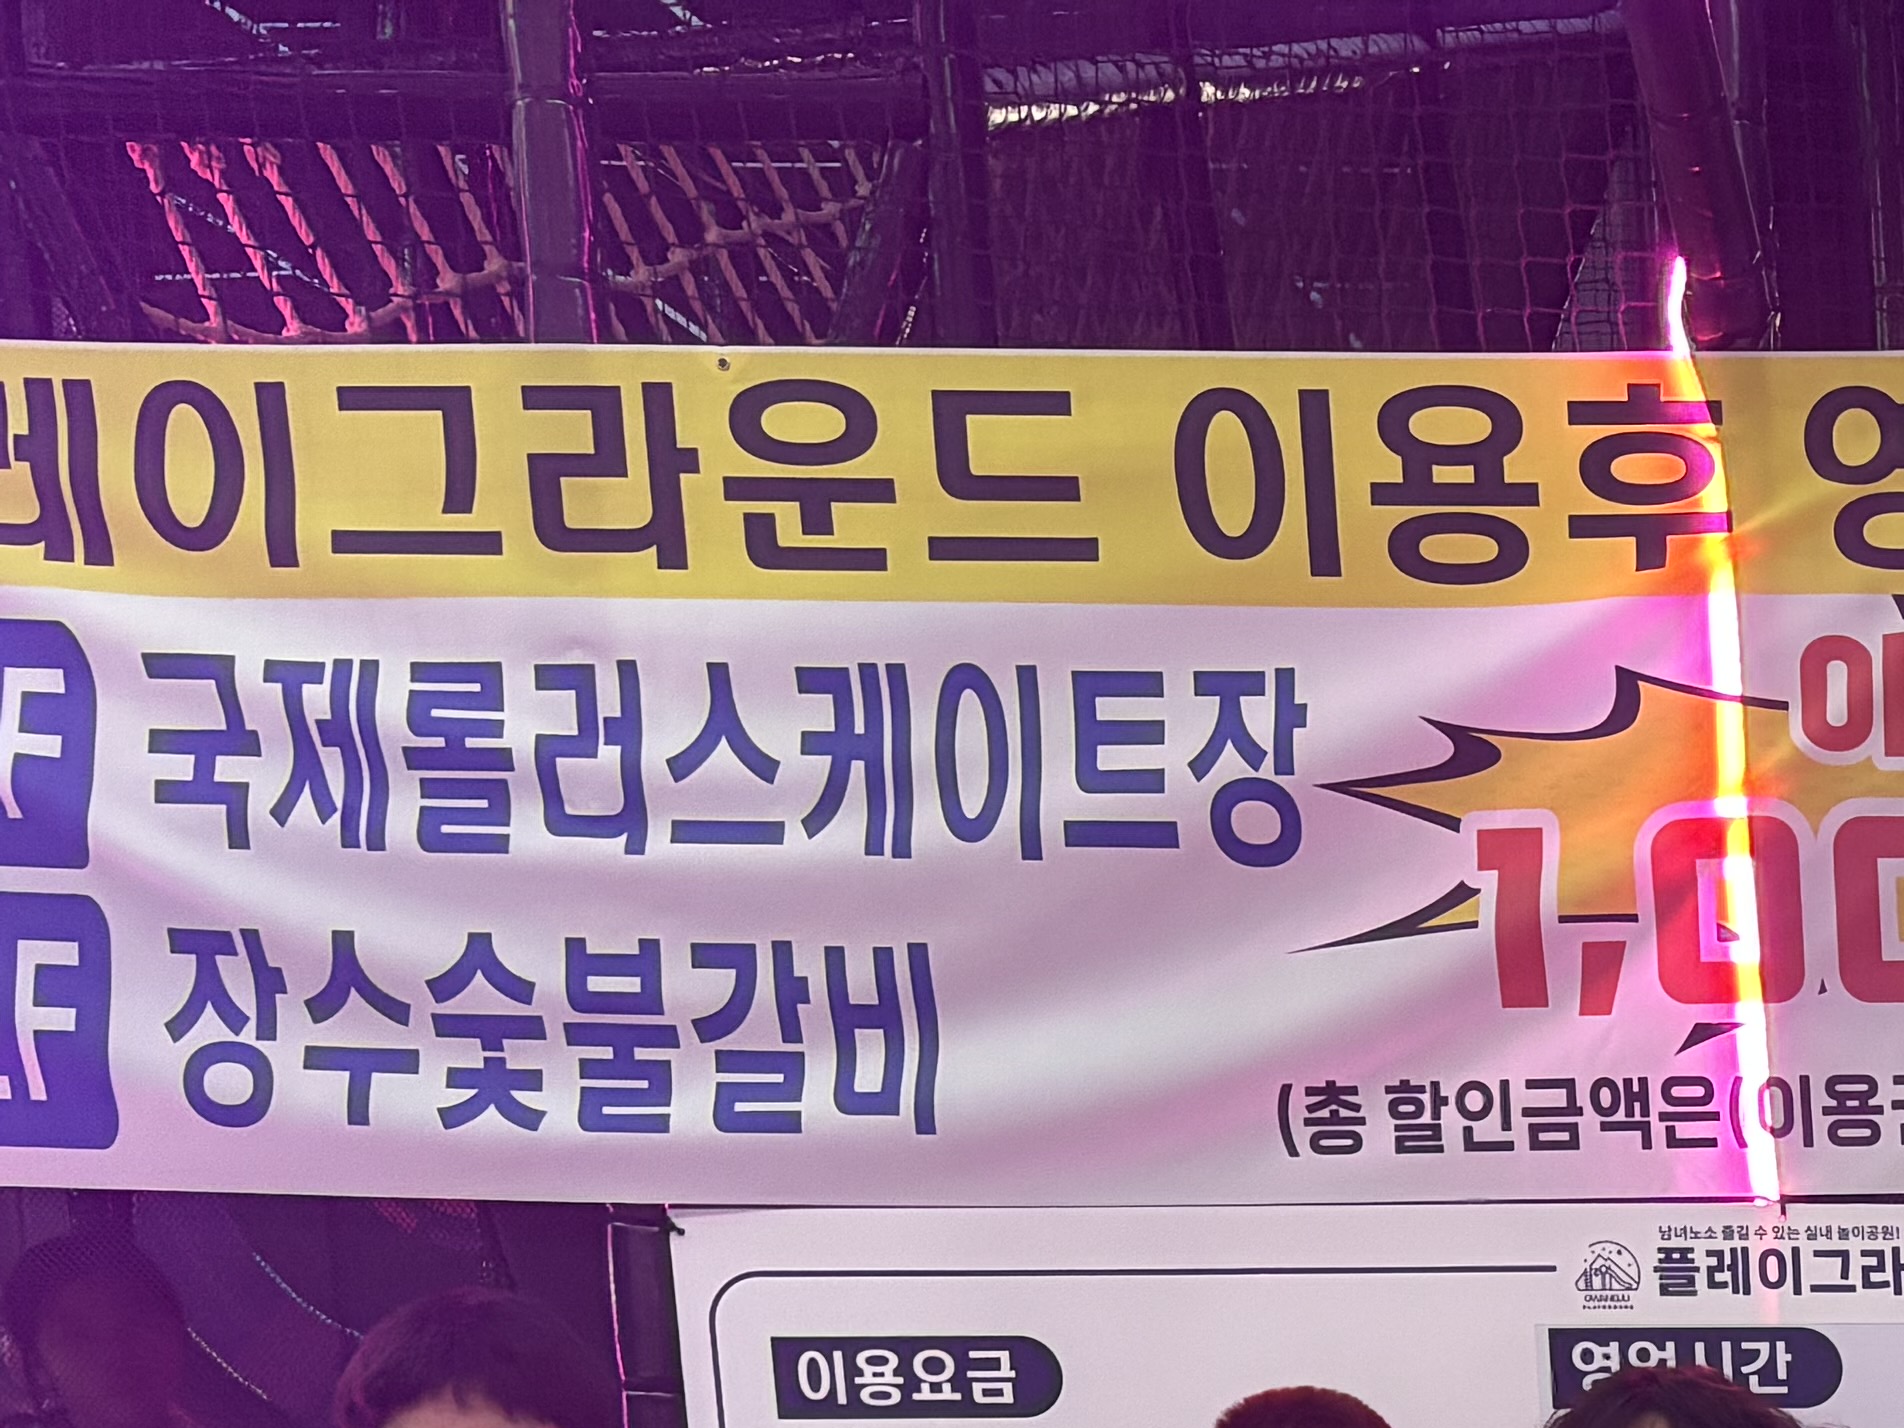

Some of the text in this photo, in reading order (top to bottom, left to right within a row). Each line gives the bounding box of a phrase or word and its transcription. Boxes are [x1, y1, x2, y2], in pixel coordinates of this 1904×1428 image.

[1174, 385, 1726, 585] 이용후
[141, 653, 1307, 868] 국제롤러스케이트장
[0, 938, 80, 1102] F
[165, 927, 939, 1135] 장수숯불갈비
[1278, 1080, 1366, 1157] (총
[1658, 1224, 1718, 1240] 남녀노소
[1753, 1224, 1768, 1240] 수
[1772, 1224, 1801, 1240] 있는
[1804, 1224, 1833, 1240] 실내
[1836, 1224, 1901, 1240] 놀이공원!
[798, 1349, 1015, 1405] 이용요금
